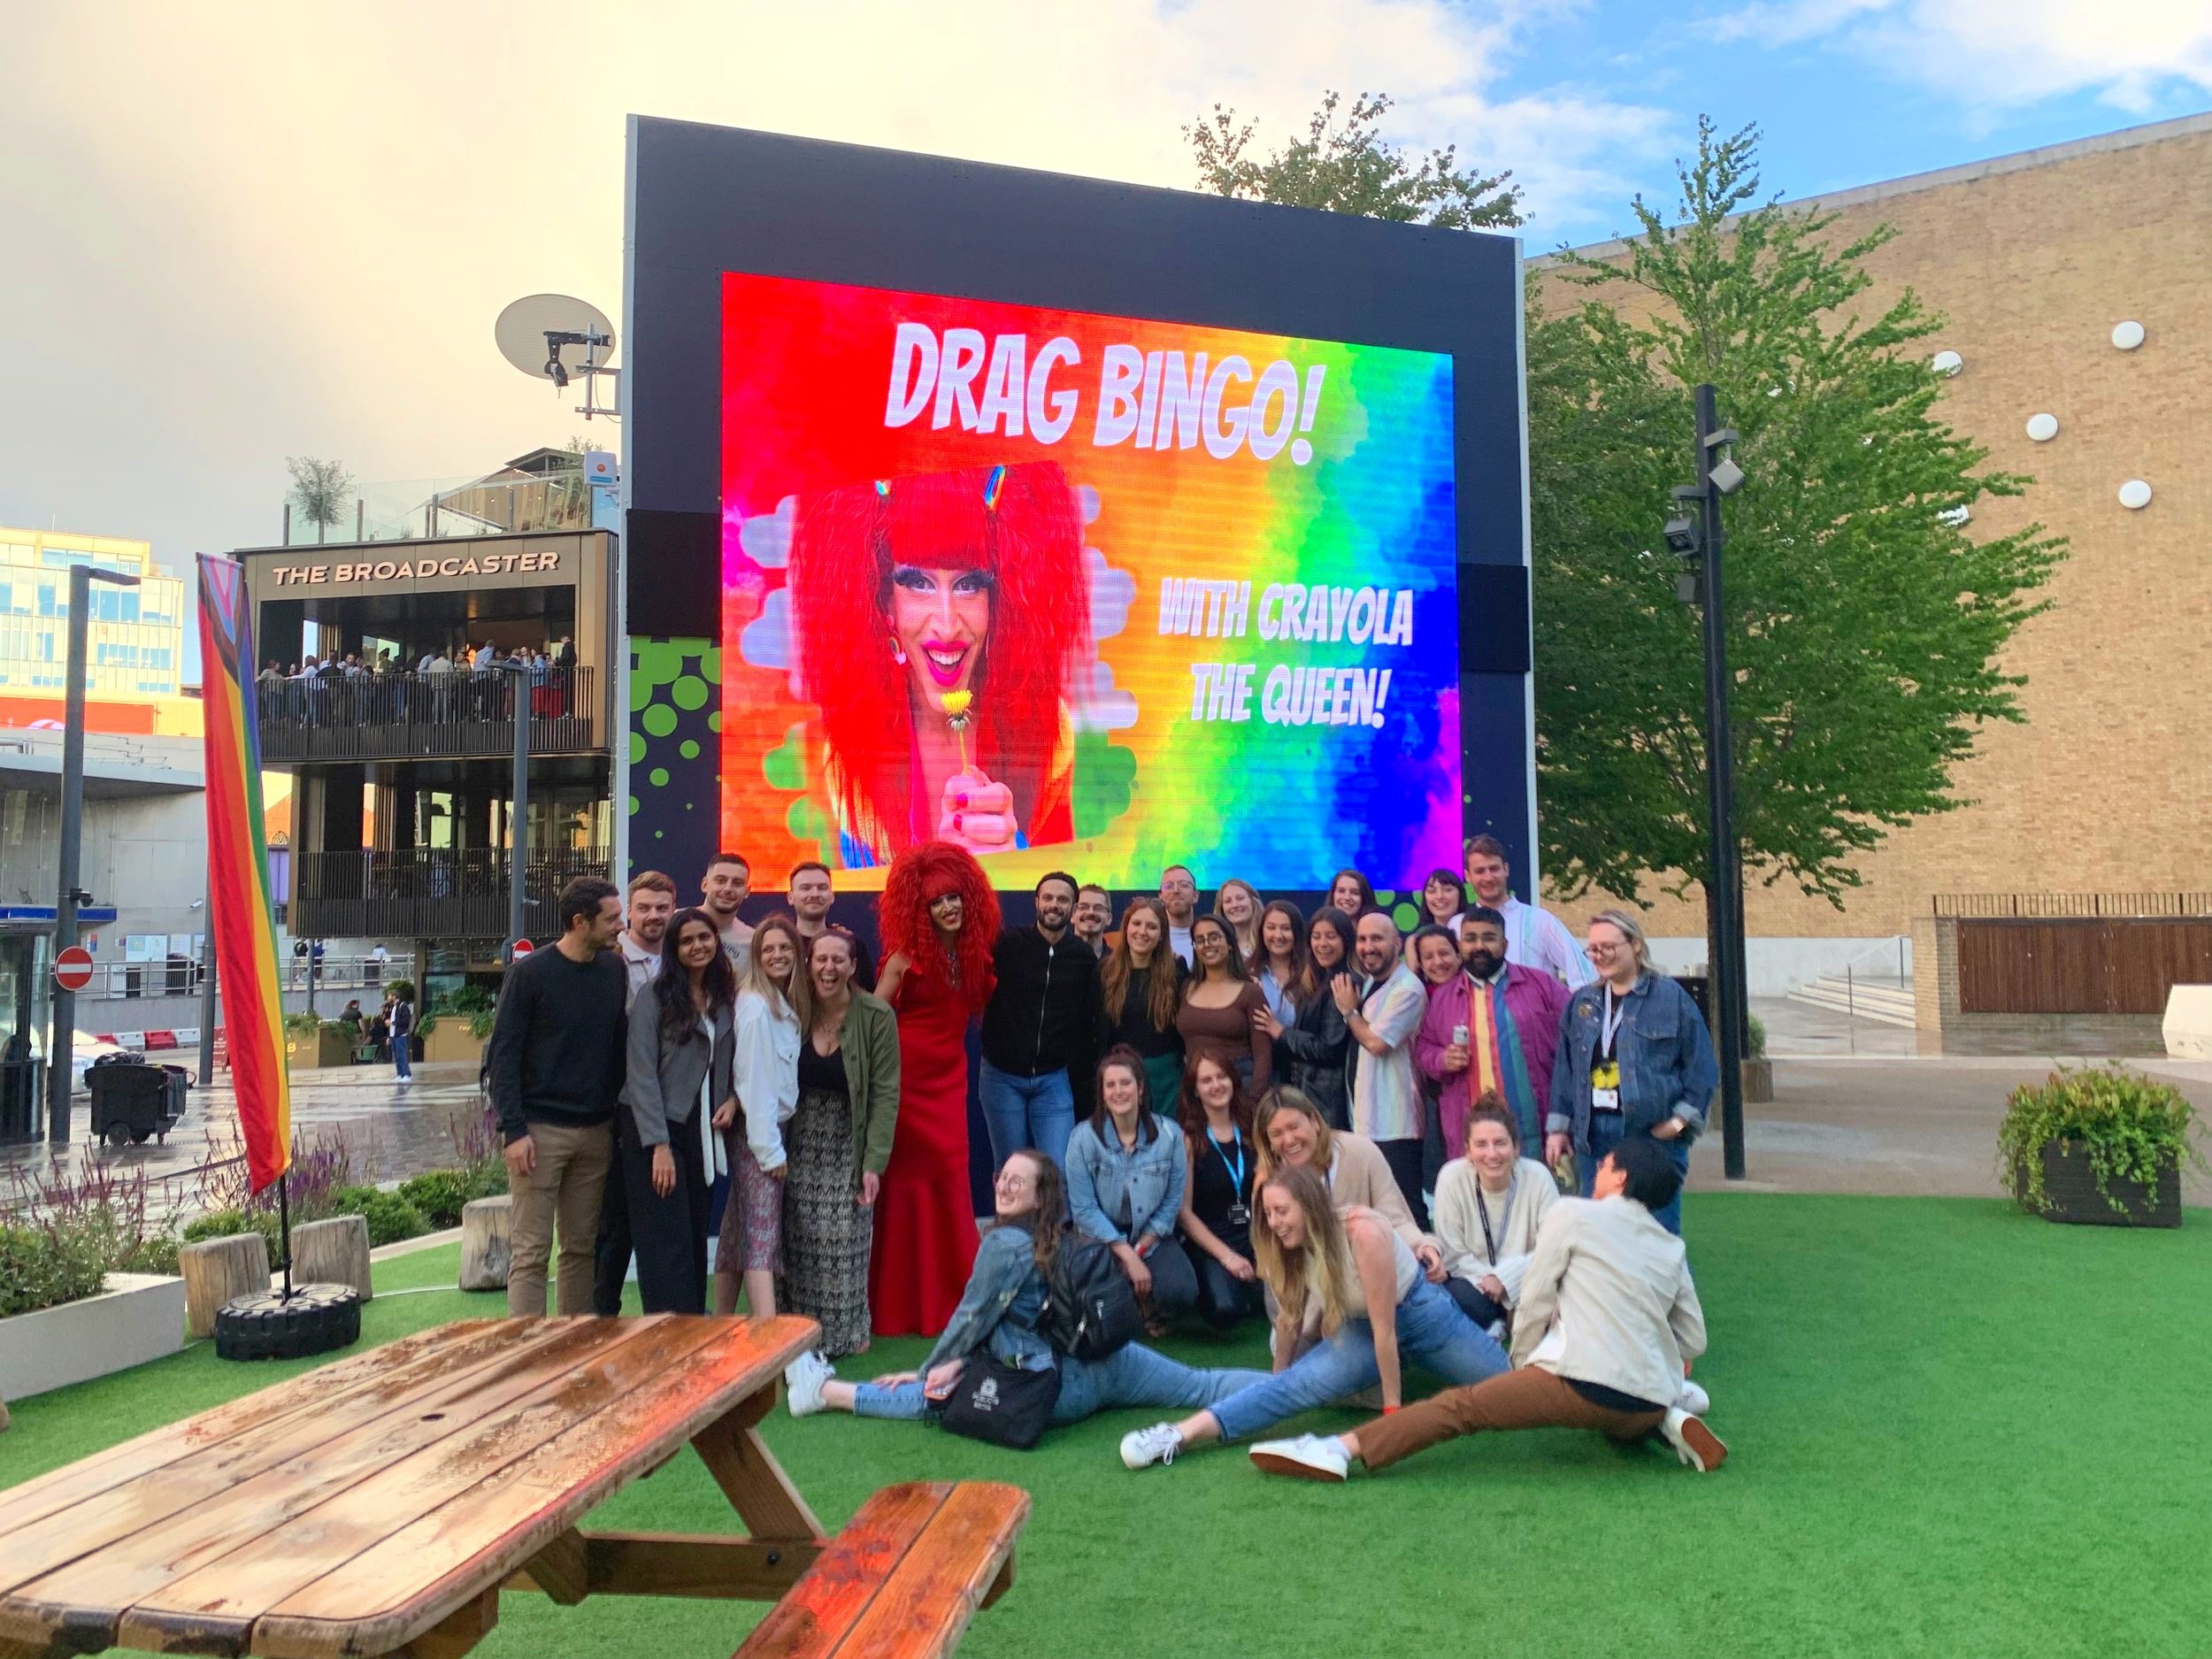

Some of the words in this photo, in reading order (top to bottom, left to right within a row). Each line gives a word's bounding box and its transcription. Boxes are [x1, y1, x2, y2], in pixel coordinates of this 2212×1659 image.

[884, 322, 1082, 445] DRAG
[1093, 343, 1326, 466] BINGO!
[273, 566, 329, 586] THE
[334, 551, 560, 583] BROADCASTER
[1158, 577, 1251, 638] WITH
[1257, 583, 1414, 647] CRAYOLA
[1190, 662, 1257, 722] THE
[1261, 664, 1393, 729] QUEEN!
